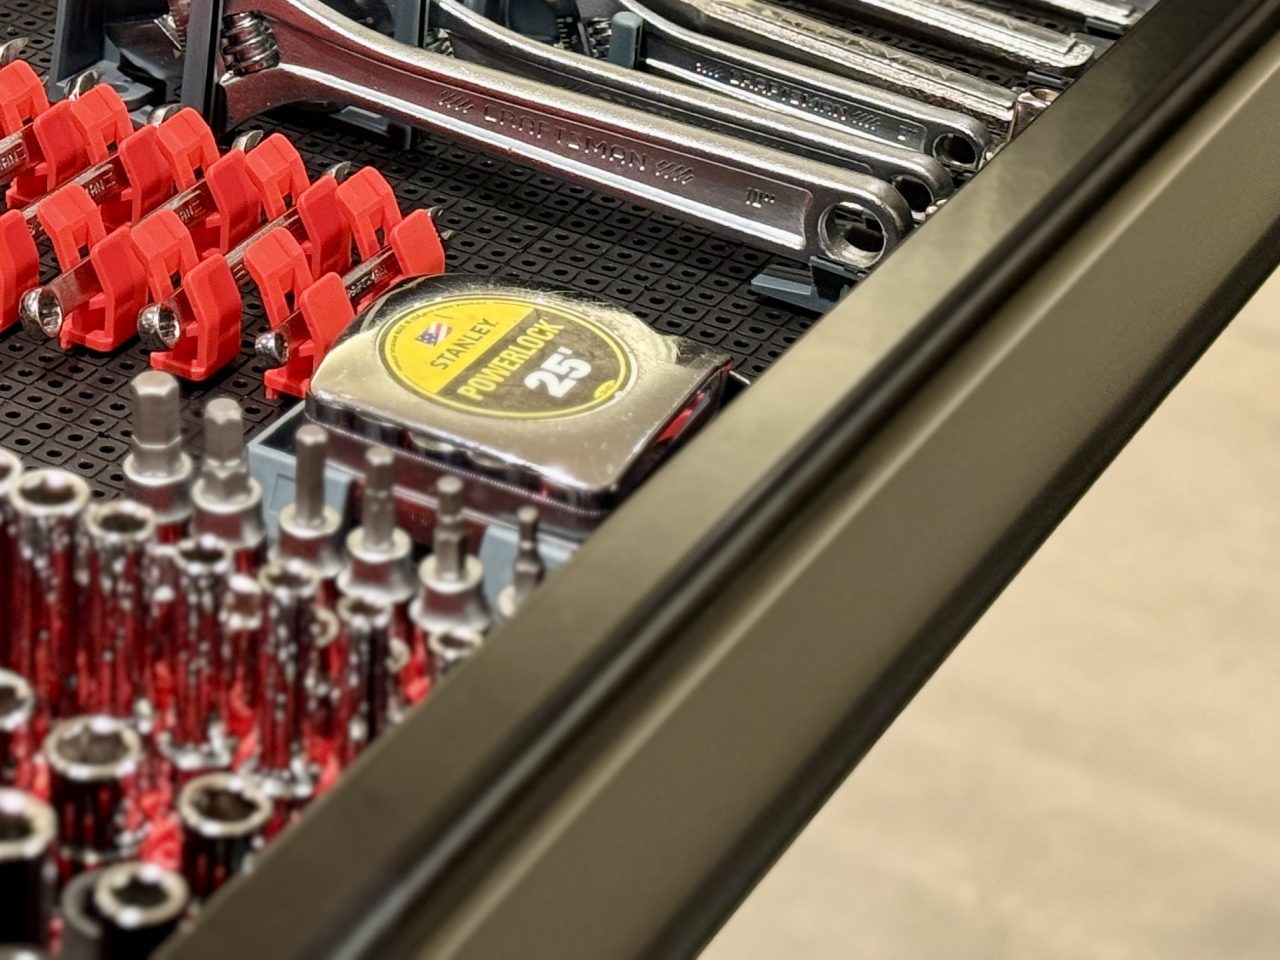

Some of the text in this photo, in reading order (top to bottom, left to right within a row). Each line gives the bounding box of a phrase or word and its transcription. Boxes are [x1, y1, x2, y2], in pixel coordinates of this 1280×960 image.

[484, 103, 647, 171] CRAFTSMAN
[430, 317, 497, 371] STANLEY
[456, 317, 565, 401] POWERLOCK
[523, 345, 592, 399] 25'
